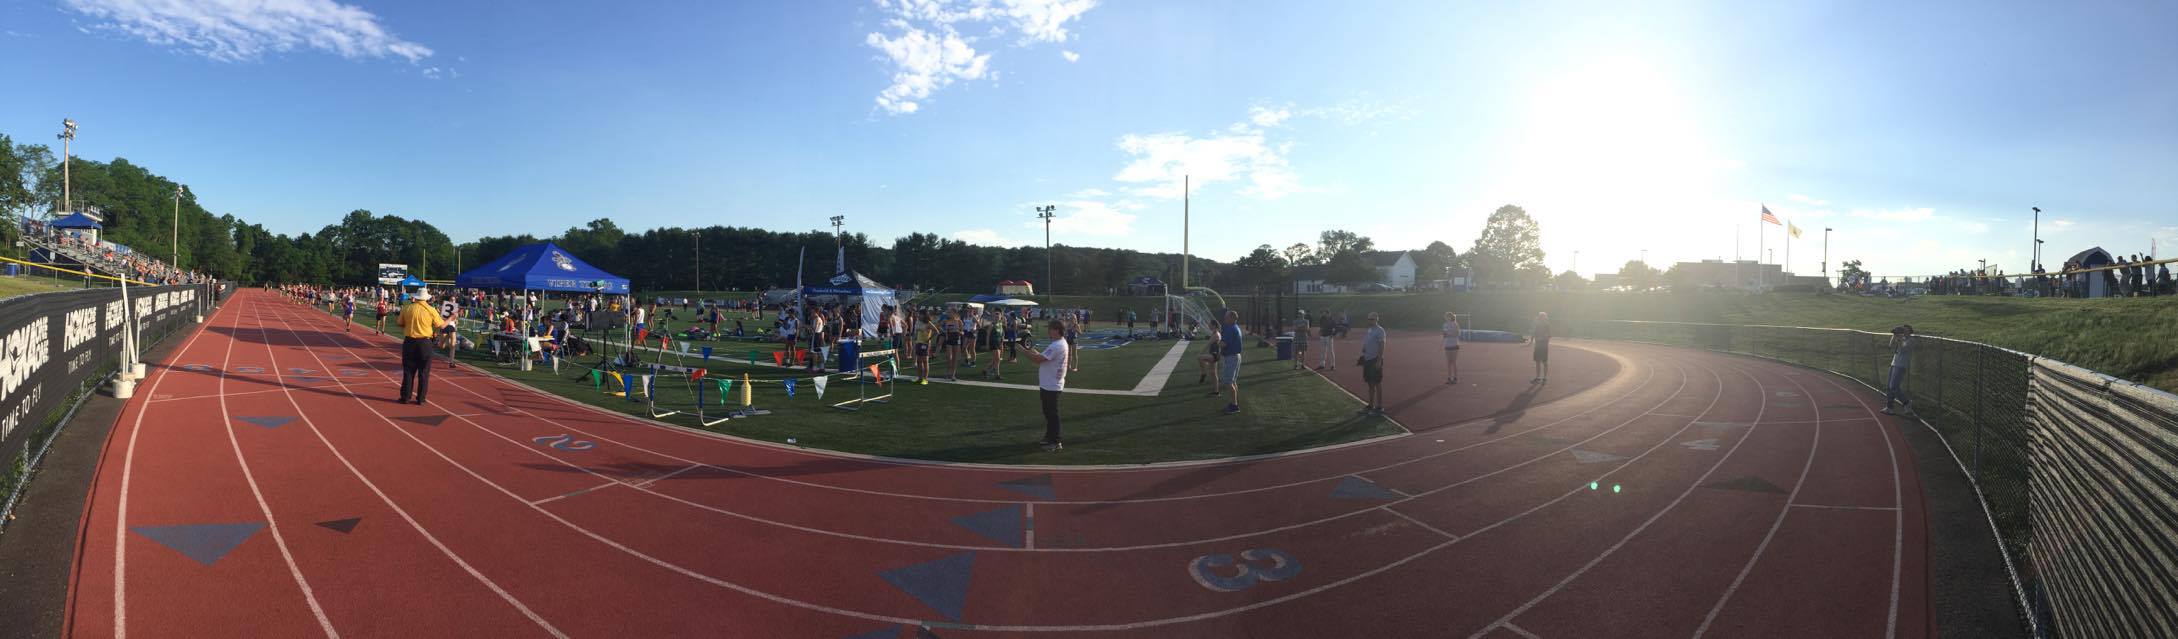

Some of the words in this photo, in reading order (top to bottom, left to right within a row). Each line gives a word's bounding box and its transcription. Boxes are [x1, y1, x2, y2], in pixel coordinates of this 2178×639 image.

[64, 308, 88, 353] HOKA
[443, 303, 454, 319] 3
[1, 405, 20, 442] TIME
[22, 394, 31, 419] TO
[32, 381, 42, 408] FLY
[532, 433, 598, 452] 2
[1188, 547, 1303, 593] 3
